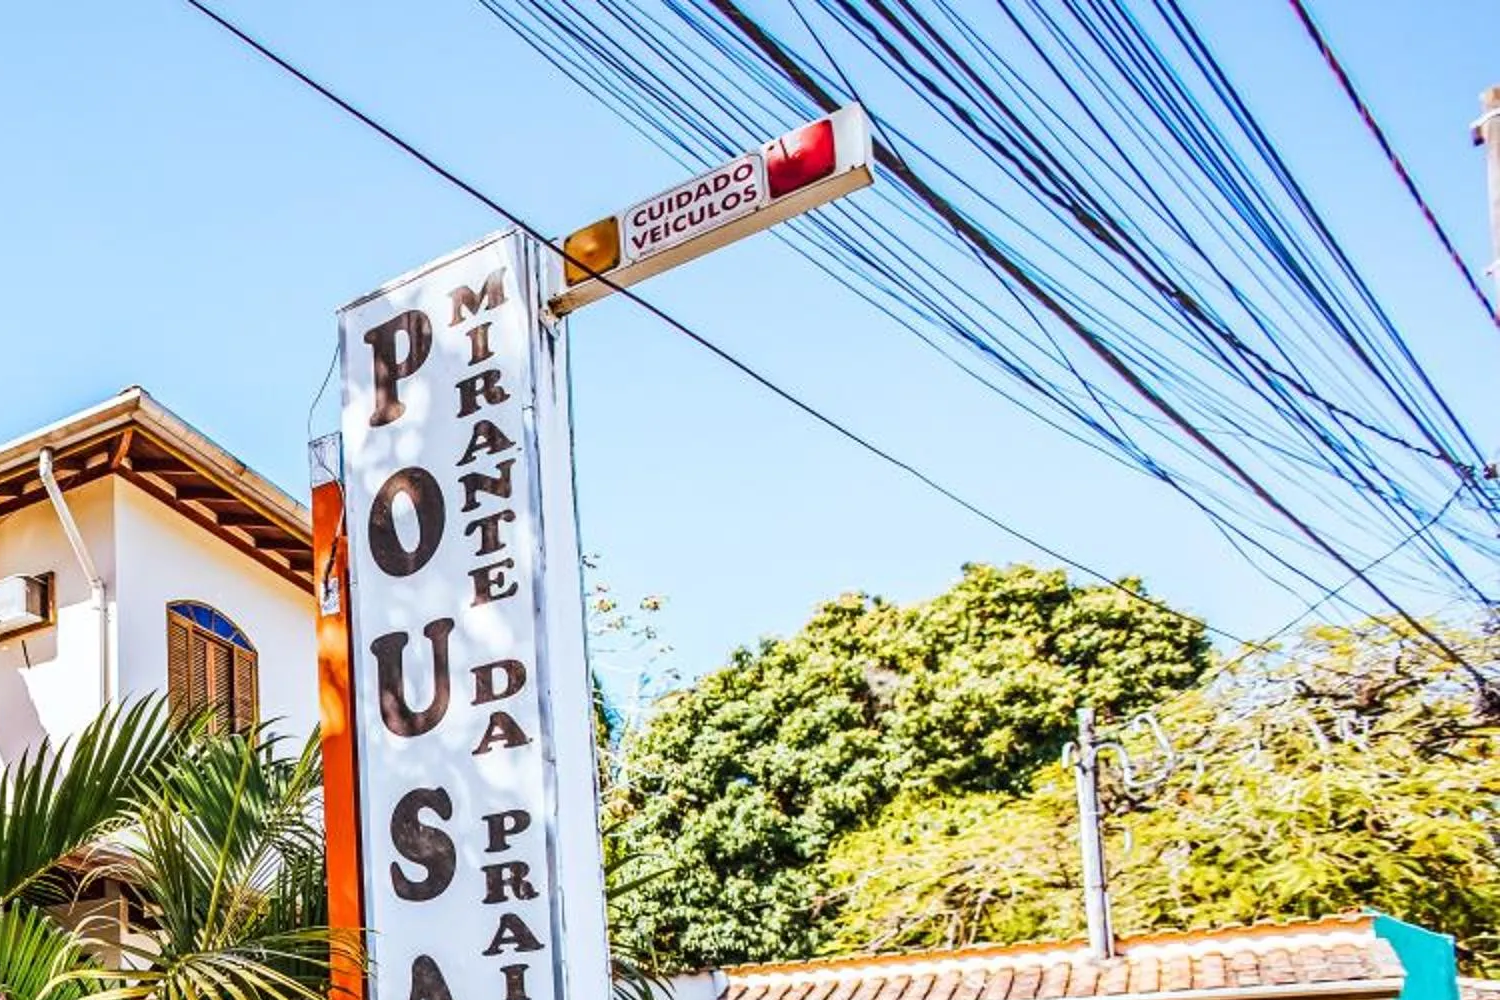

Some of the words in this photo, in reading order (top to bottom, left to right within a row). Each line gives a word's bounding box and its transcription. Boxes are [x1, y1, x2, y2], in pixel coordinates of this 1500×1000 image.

[633, 163, 753, 227] CUIDADO
[449, 267, 518, 607] MIRANTE
[470, 658, 533, 756] DA
